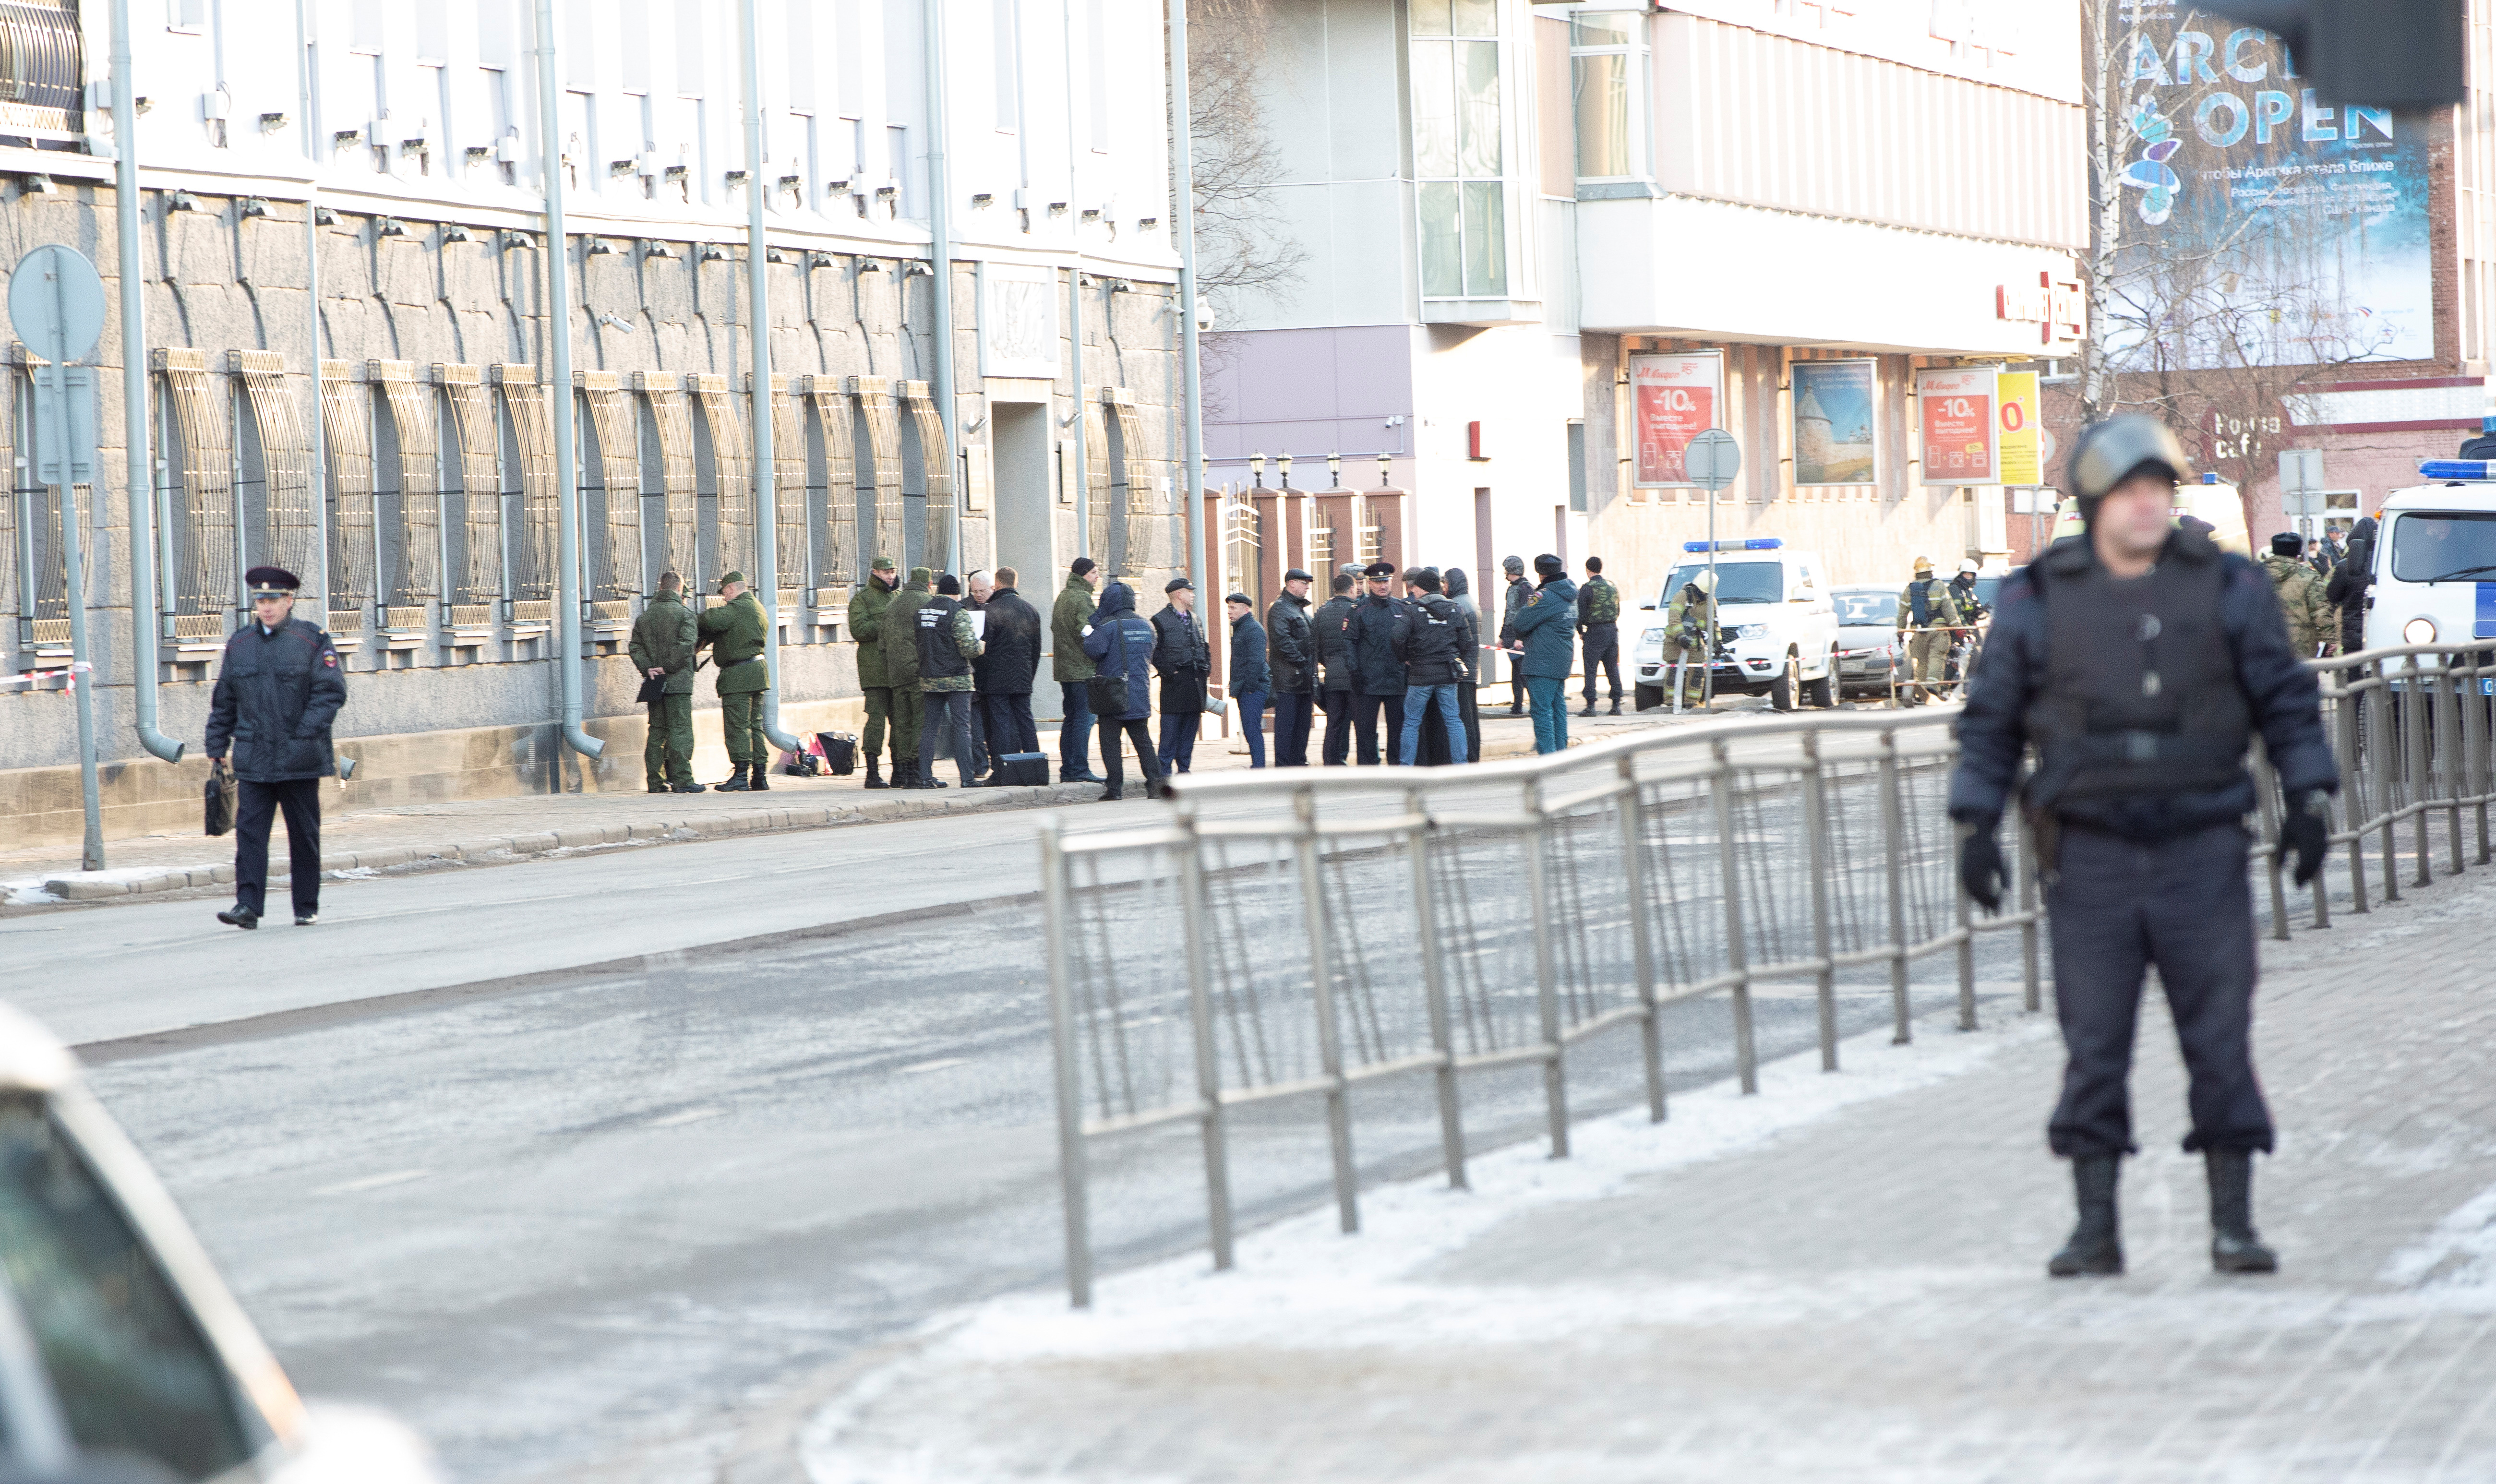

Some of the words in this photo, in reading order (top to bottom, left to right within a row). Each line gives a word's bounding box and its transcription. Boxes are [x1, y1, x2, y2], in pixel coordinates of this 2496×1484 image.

[2193, 87, 2393, 148] OPEN
[2244, 166, 2302, 180] Арктика
[2349, 159, 2395, 173] ближе
[1653, 389, 1697, 411] -10%
[1937, 398, 1976, 418] -10%
[1650, 414, 1684, 422] Вместе
